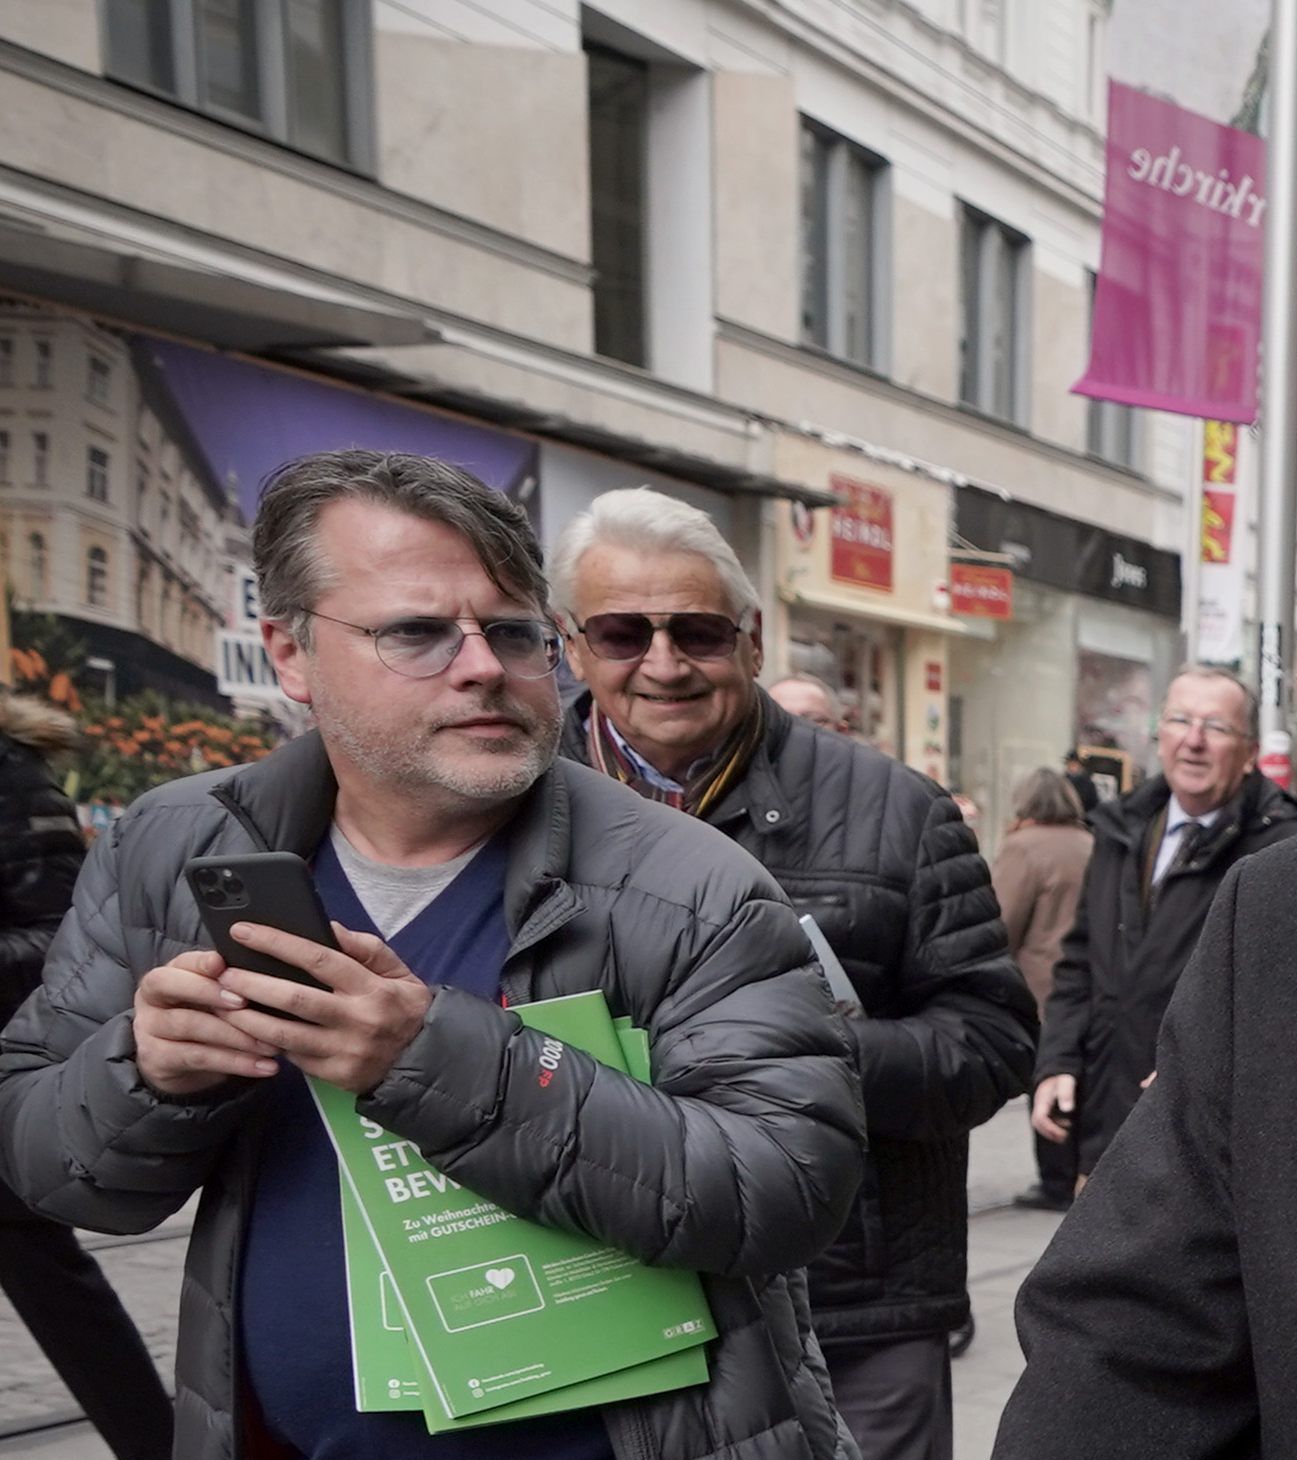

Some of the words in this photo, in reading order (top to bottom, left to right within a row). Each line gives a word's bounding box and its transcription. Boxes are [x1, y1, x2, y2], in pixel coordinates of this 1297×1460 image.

[403, 1219, 421, 1231] Zu
[422, 1203, 501, 1226] Weihnachte
[408, 1230, 428, 1243] mit
[430, 1211, 517, 1237] GUTSCHEIN-
